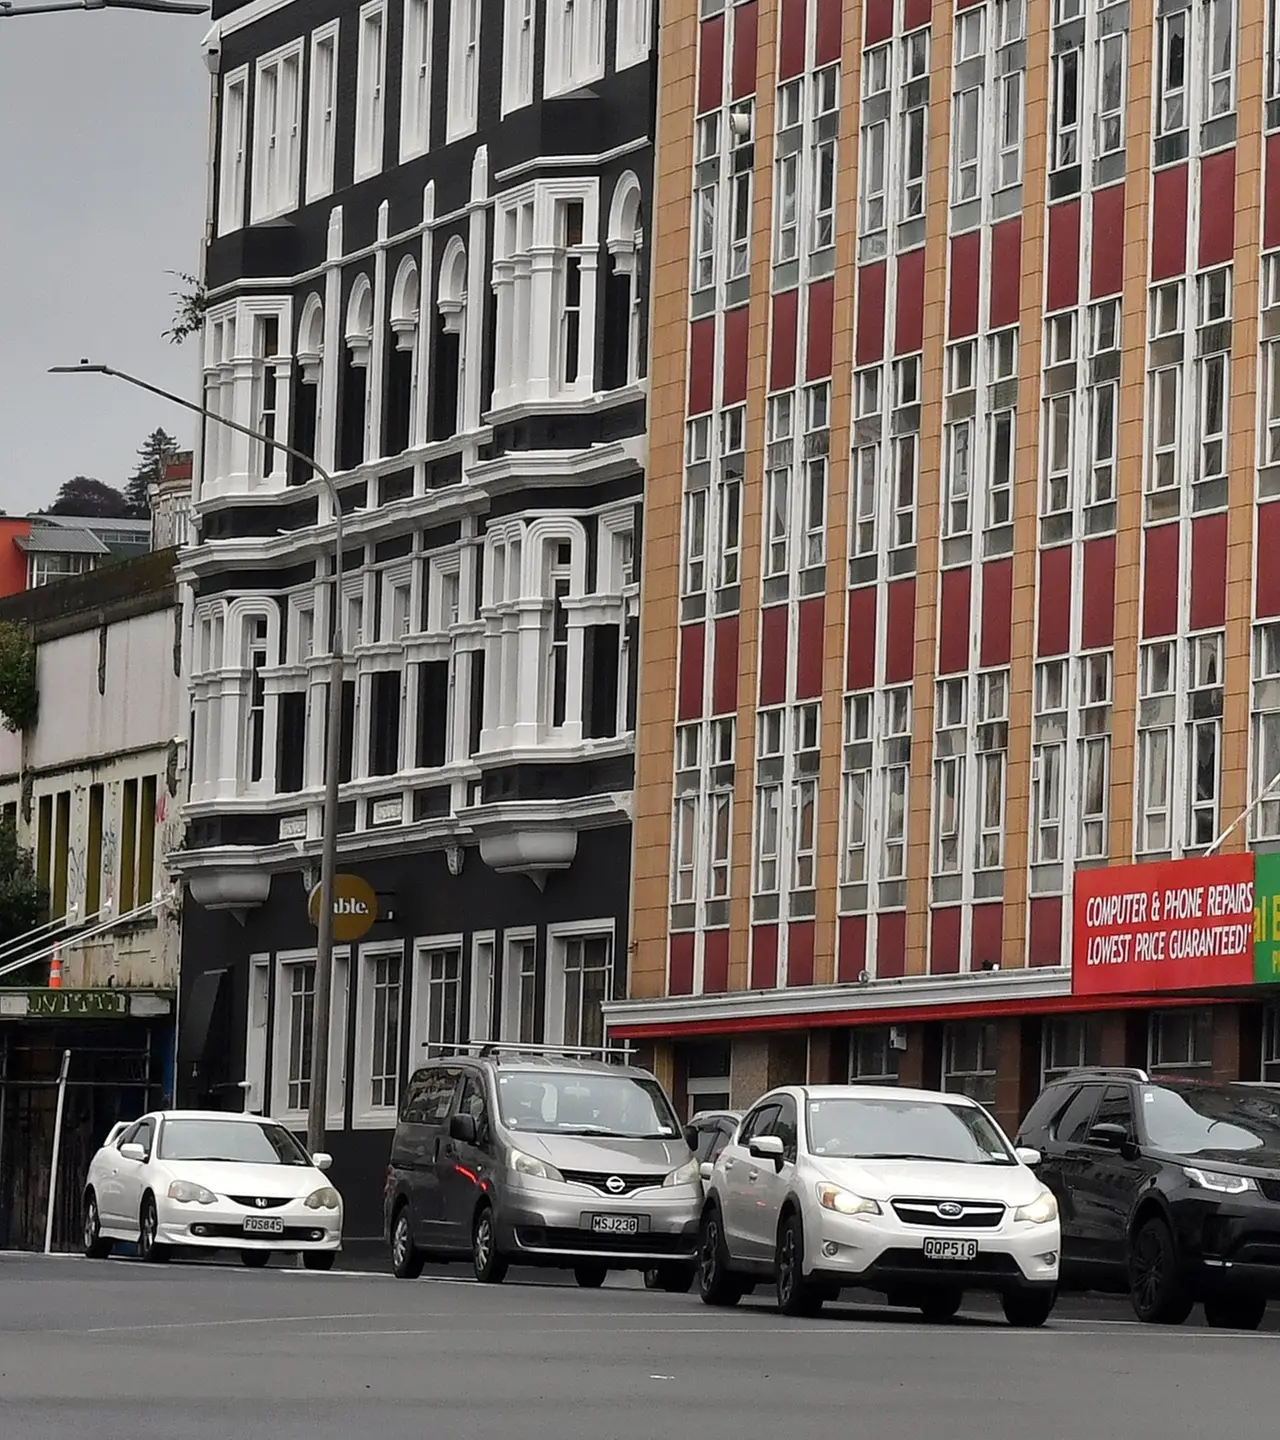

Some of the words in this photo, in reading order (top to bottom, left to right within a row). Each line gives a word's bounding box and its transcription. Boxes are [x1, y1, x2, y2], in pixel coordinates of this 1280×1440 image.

[1086, 891, 1147, 927] COMPUTER
[1150, 891, 1161, 921] &
[1163, 886, 1204, 920] PHONE
[1206, 881, 1254, 916] REPAIRS
[1087, 932, 1131, 966] LOWEST
[1134, 928, 1166, 961] PRICE
[926, 1241, 976, 1256] QQP518
